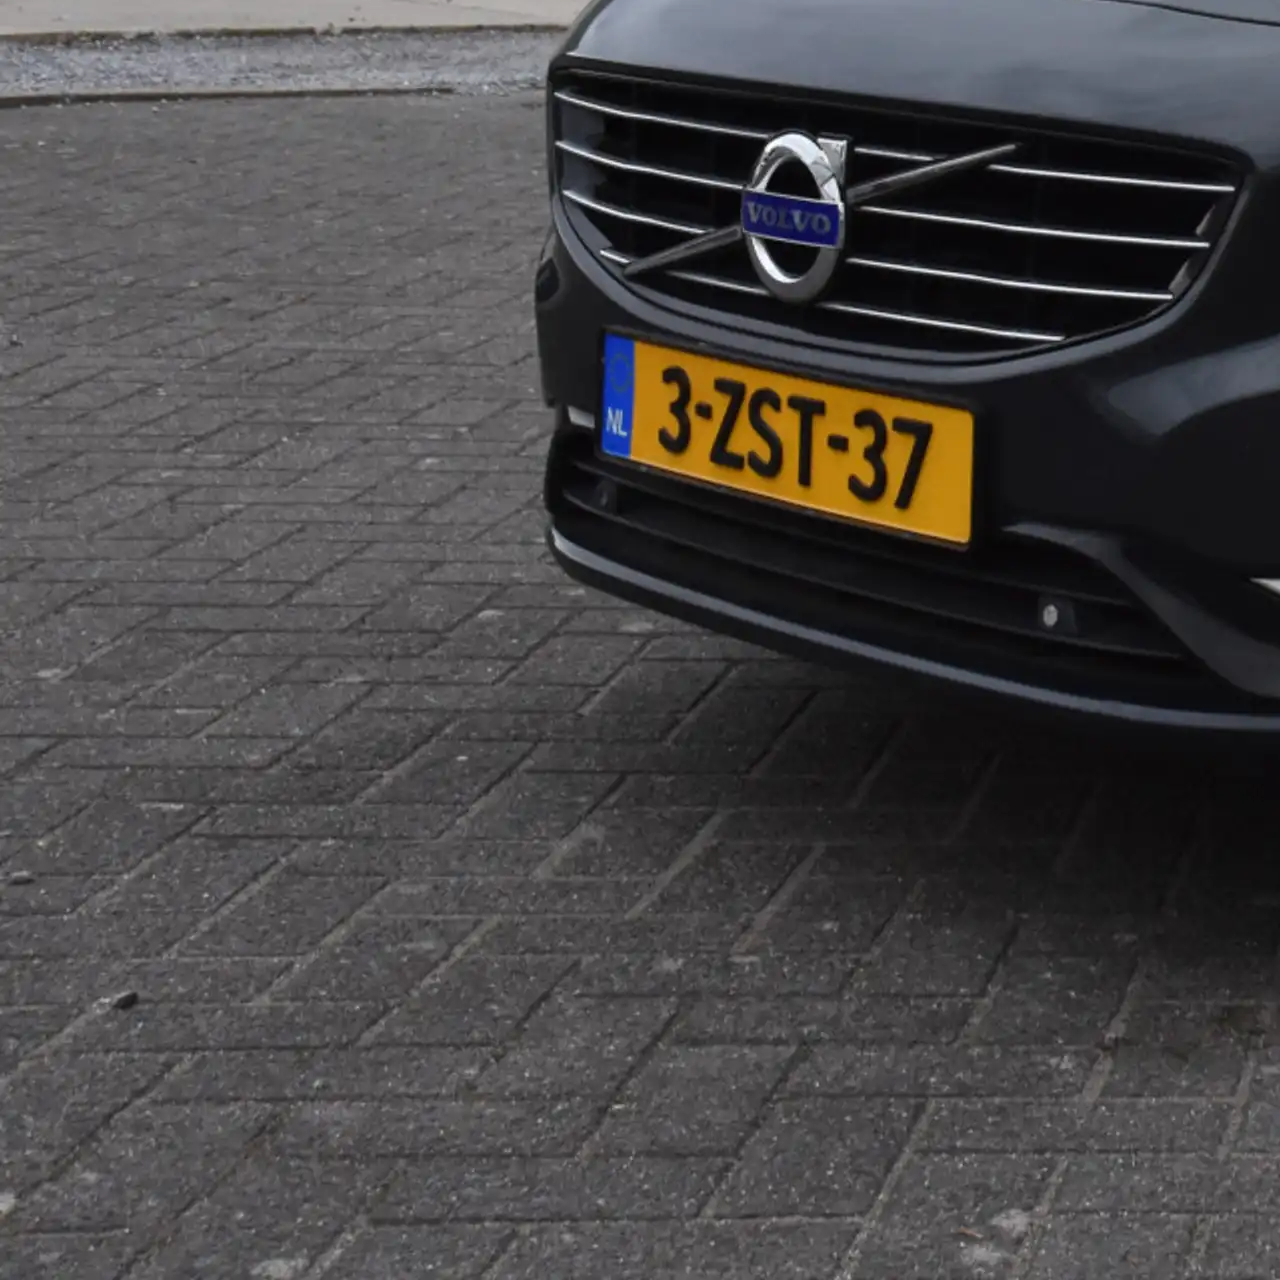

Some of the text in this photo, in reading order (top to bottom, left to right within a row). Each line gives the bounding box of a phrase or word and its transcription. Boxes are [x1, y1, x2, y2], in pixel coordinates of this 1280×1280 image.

[746, 201, 832, 235] VOLVO
[606, 406, 628, 437] NL
[658, 365, 933, 510] 3-ZST-37
